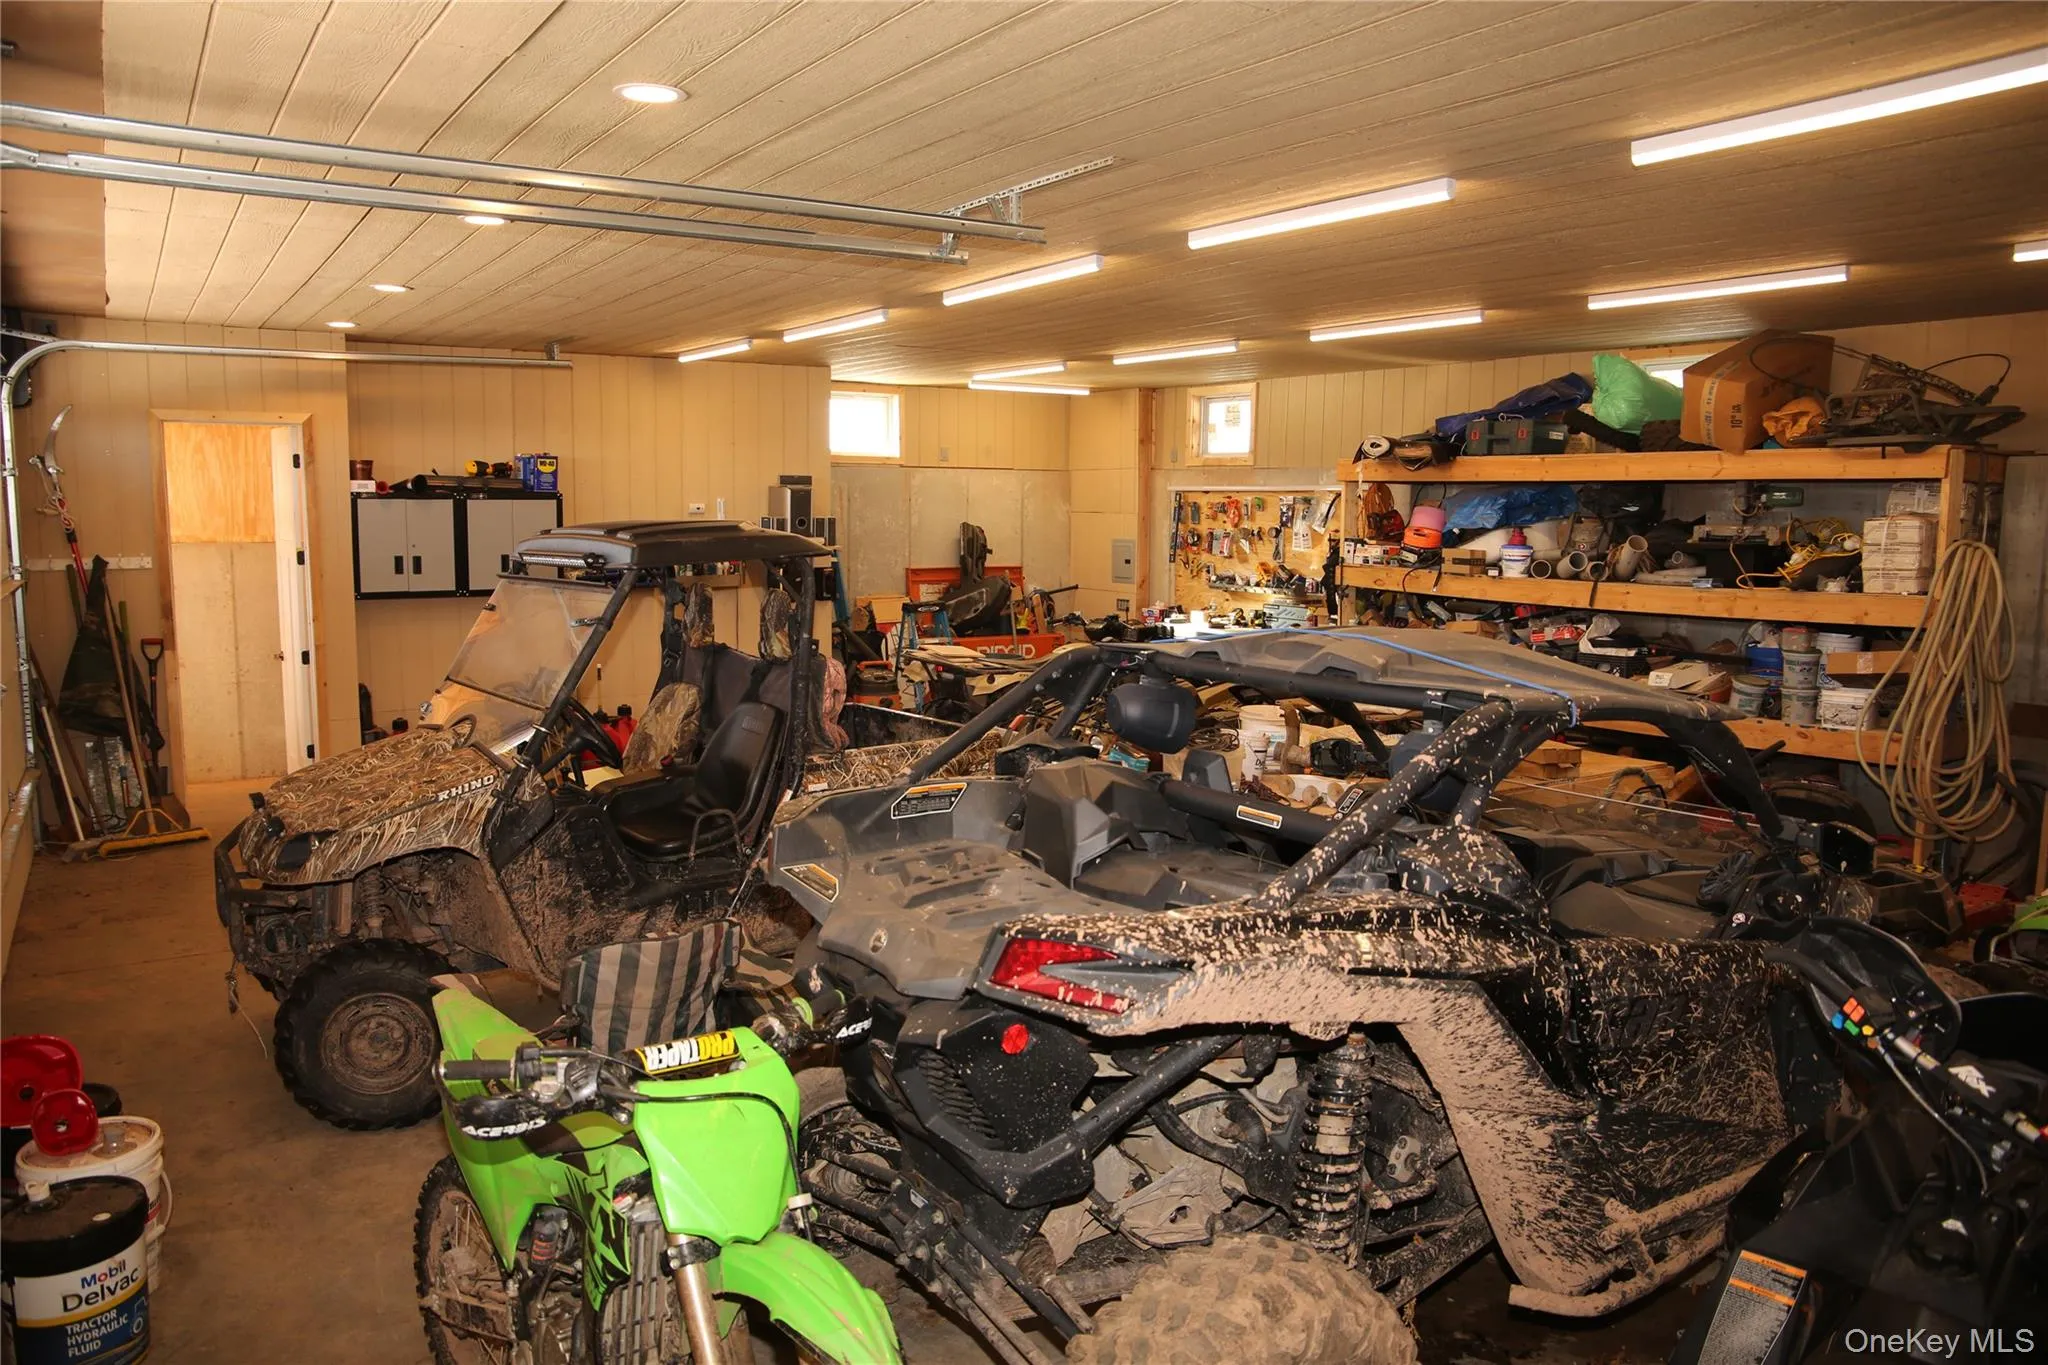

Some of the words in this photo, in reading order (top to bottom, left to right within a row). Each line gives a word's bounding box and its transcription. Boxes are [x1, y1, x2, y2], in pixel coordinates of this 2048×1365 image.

[437, 774, 495, 802] RHINO
[80, 1259, 127, 1289] Mobil
[61, 1267, 139, 1313] Delvac
[65, 1308, 118, 1335] TRACTOR
[66, 1313, 129, 1347] HYDRAULIC
[67, 1340, 102, 1358] FLUID
